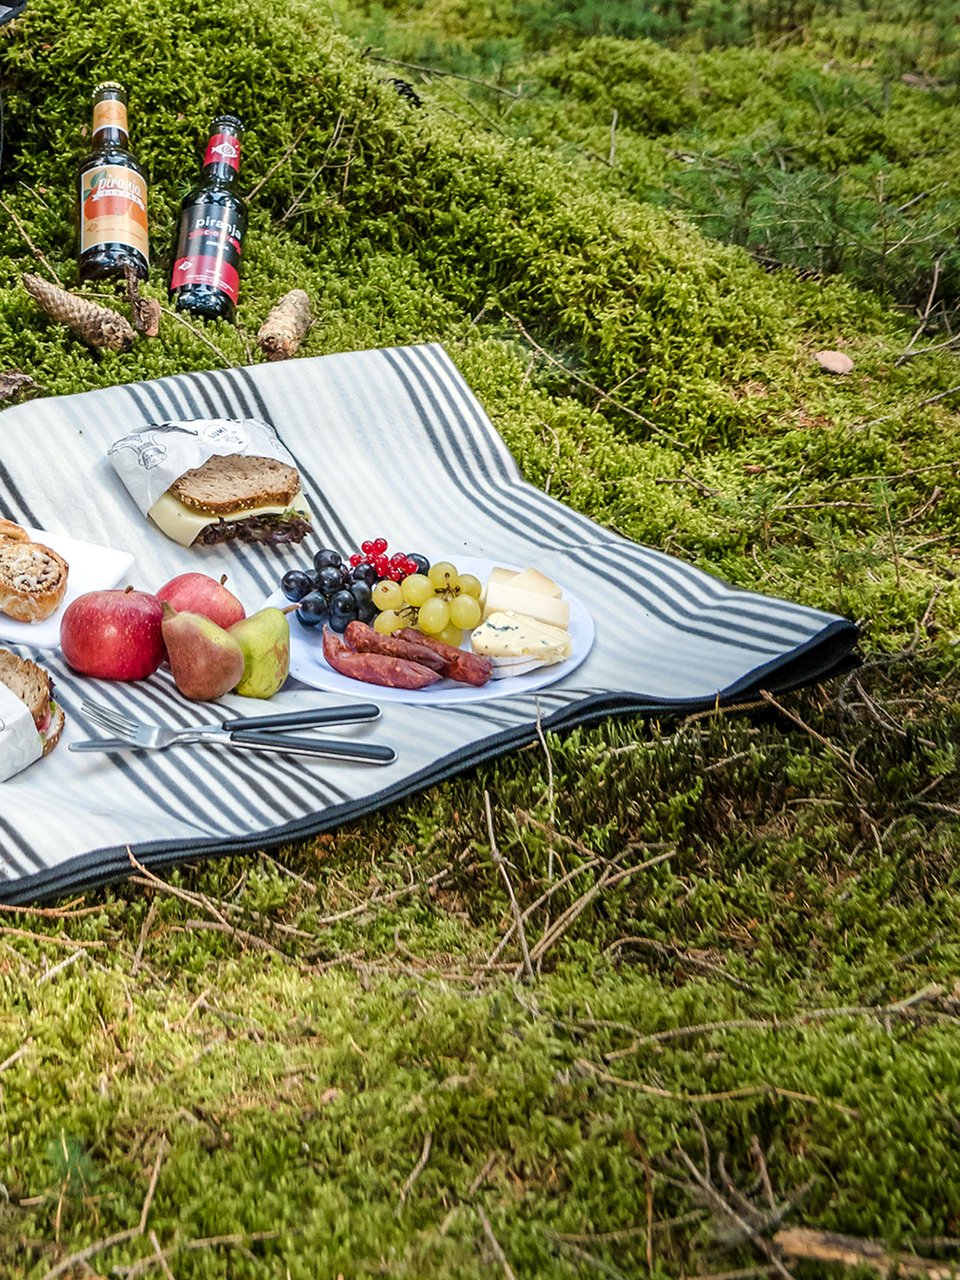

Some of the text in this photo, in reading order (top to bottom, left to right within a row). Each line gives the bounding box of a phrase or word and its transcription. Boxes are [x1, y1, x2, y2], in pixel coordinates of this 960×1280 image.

[98, 175, 141, 194] piranja
[195, 217, 242, 239] piranja
[208, 427, 227, 438] LUMI
